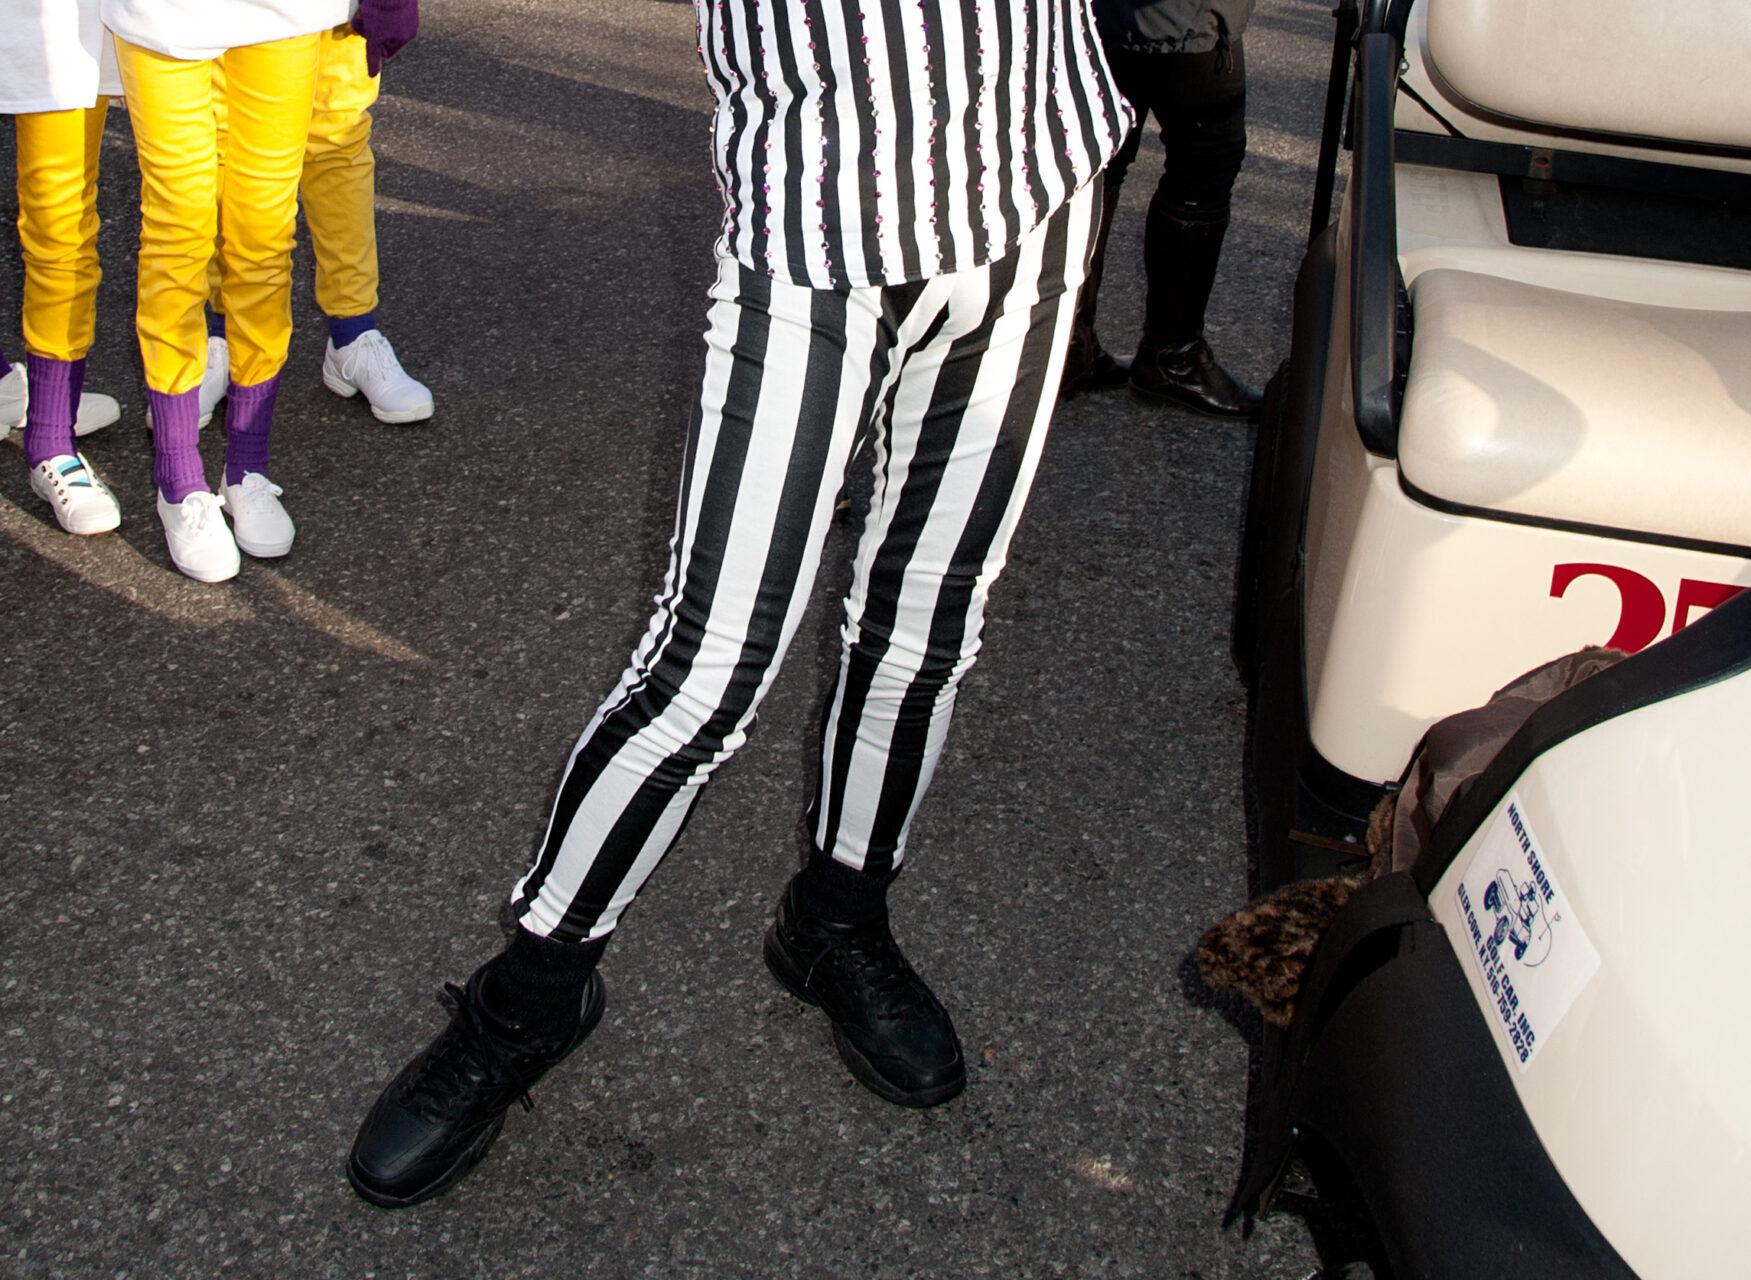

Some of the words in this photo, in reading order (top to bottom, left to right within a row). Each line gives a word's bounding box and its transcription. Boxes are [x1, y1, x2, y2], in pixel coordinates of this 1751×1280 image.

[1507, 802, 1531, 854] NORTH
[1527, 850, 1555, 905] SHORE
[1457, 882, 1471, 915] GLEN
[1487, 965, 1529, 1064] 516-759-2828
[1486, 935, 1505, 975] GOLF
[1517, 1011, 1536, 1053] INC.
